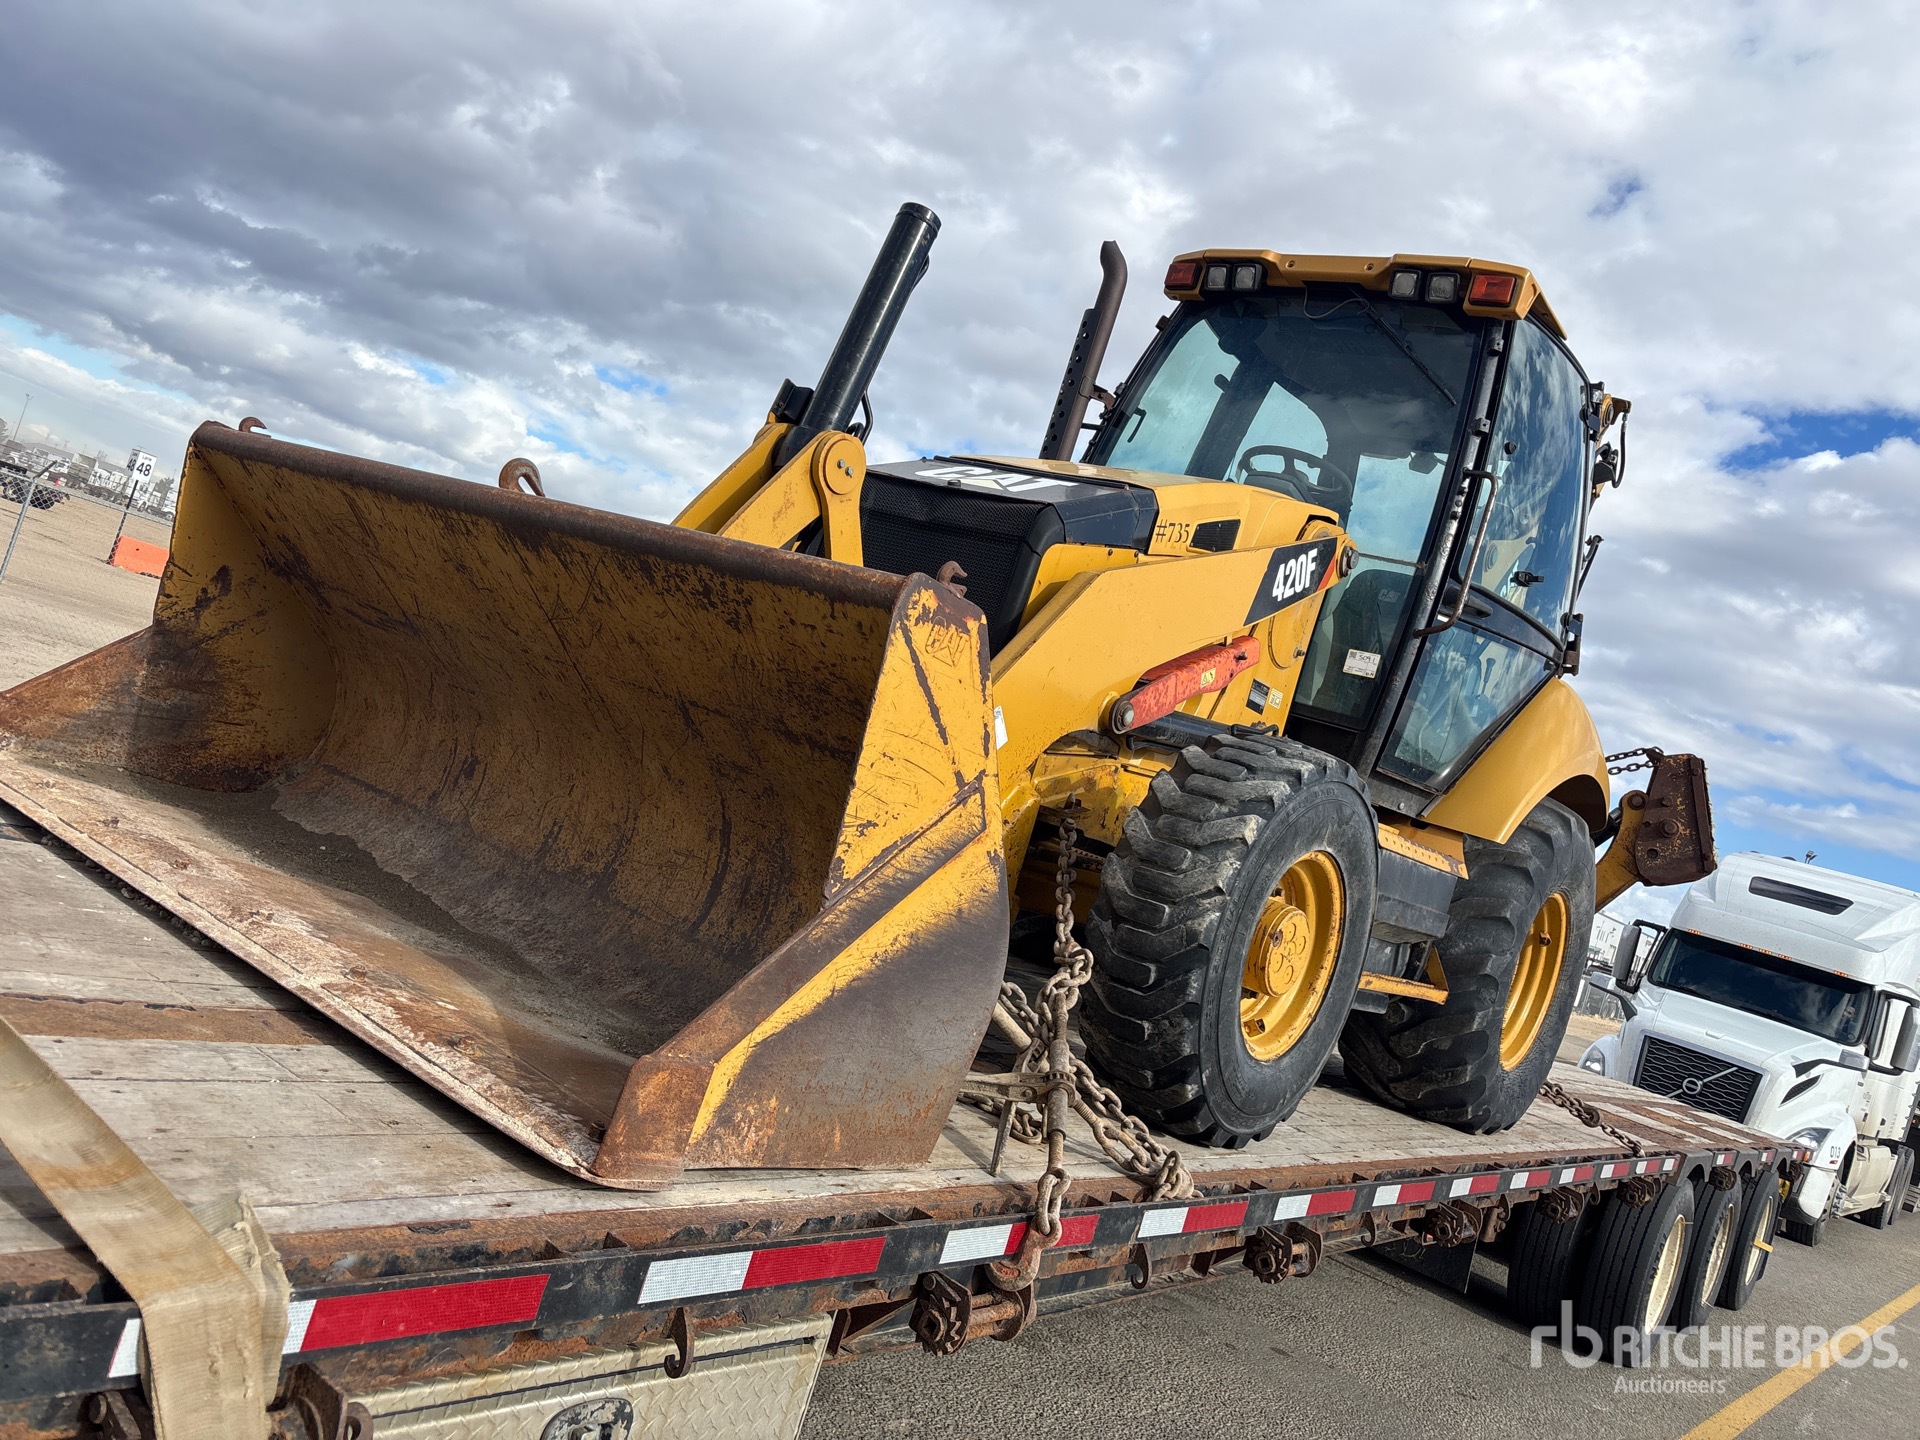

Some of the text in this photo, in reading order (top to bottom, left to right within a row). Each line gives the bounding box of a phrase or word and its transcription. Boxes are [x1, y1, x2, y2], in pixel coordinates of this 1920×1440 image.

[136, 462, 152, 477] 48
[915, 466, 1080, 492] CAT
[1155, 518, 1190, 544] #735
[1272, 548, 1318, 602] 420F
[925, 615, 970, 668] CAT
[1829, 1145, 1841, 1159] 013
